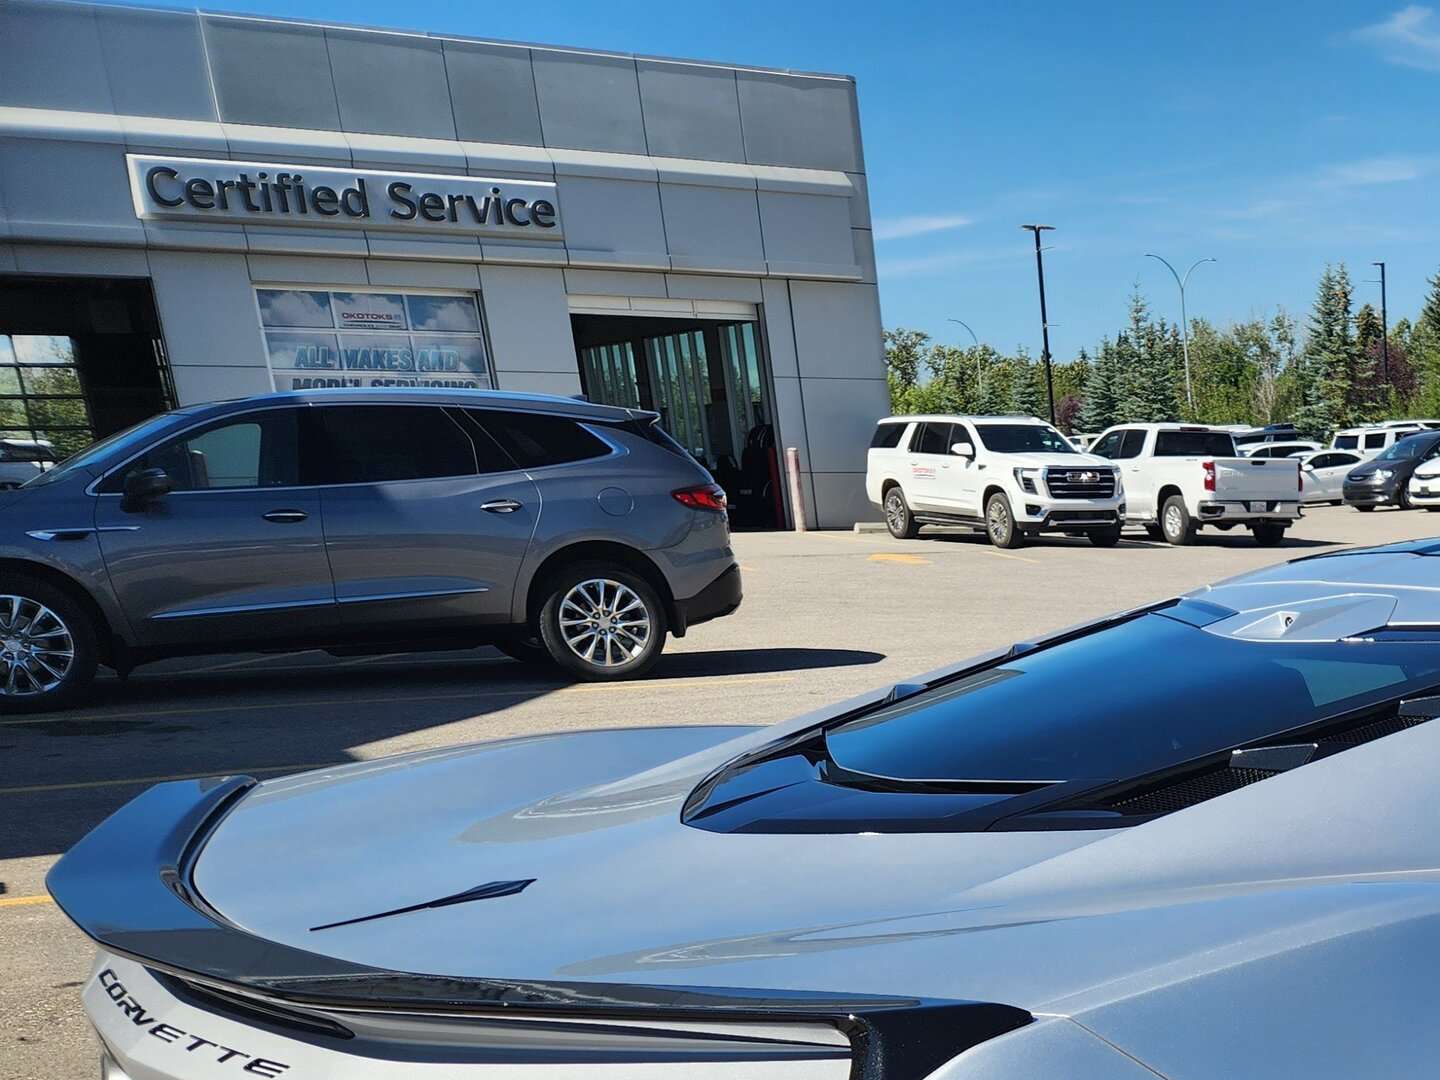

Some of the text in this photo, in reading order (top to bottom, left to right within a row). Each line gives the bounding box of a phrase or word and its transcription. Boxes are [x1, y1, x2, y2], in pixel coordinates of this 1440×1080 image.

[146, 166, 557, 228] Certified Service
[342, 312, 393, 320] OKOTOKS
[294, 345, 460, 371] ALL MAKES AND
[99, 968, 291, 1079] CORVETTE
